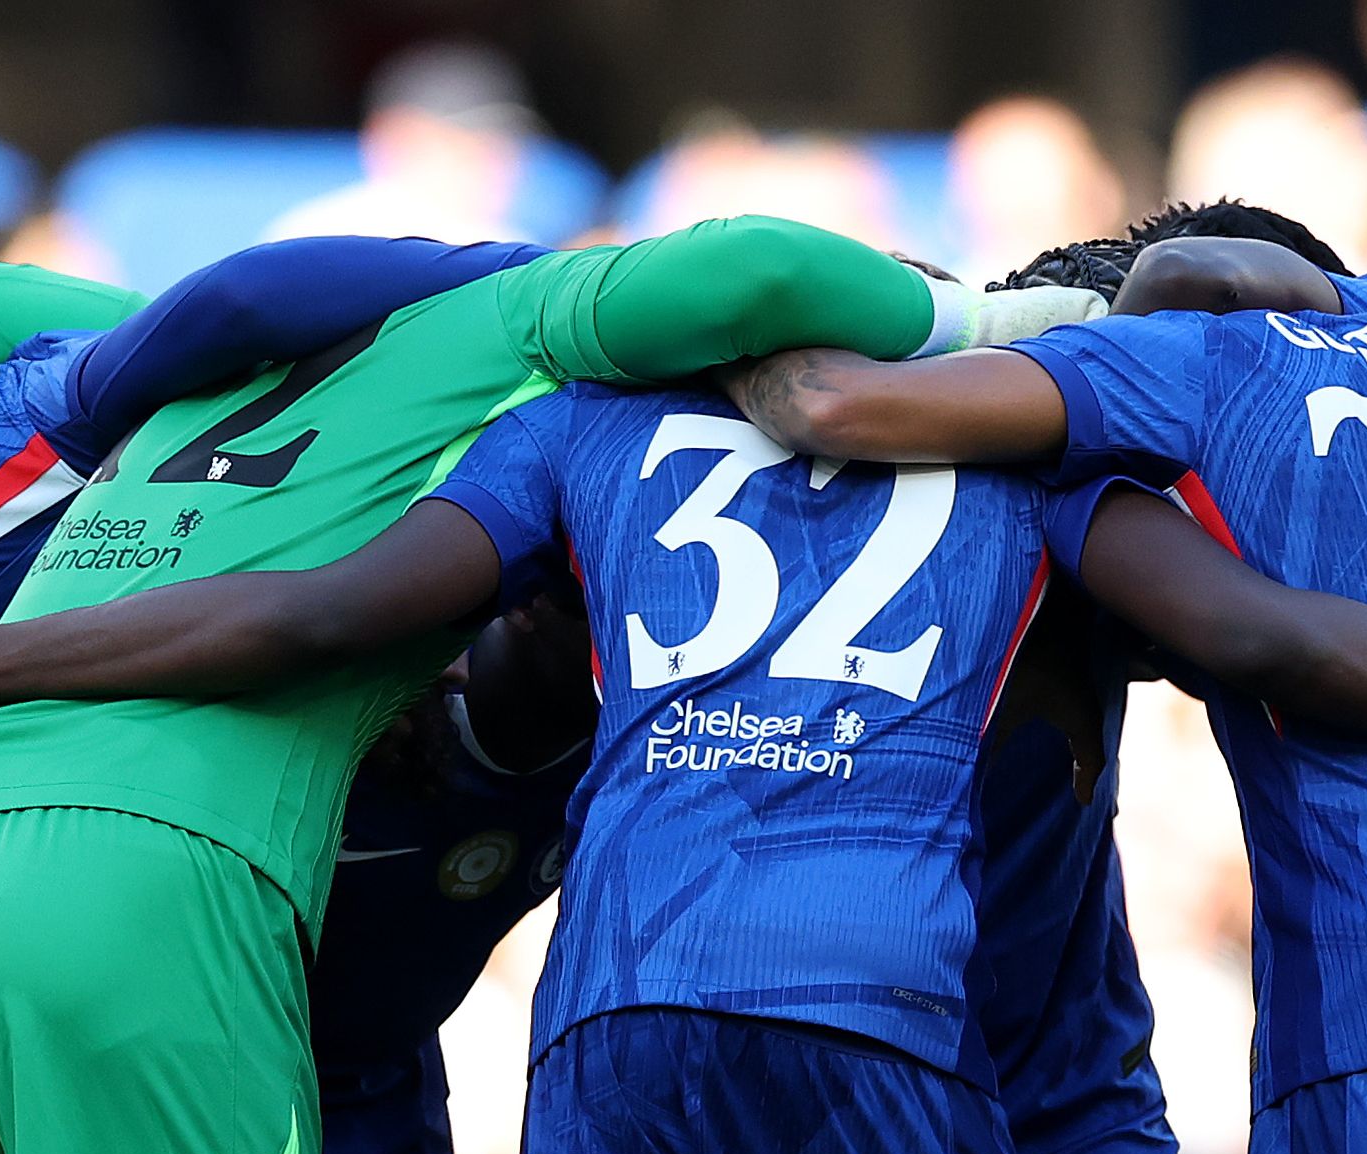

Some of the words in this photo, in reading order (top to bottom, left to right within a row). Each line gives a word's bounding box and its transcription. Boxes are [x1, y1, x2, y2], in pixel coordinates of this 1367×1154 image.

[625, 413, 957, 702] 32
[651, 699, 803, 740] Chelsea
[646, 737, 854, 780] Foundation
